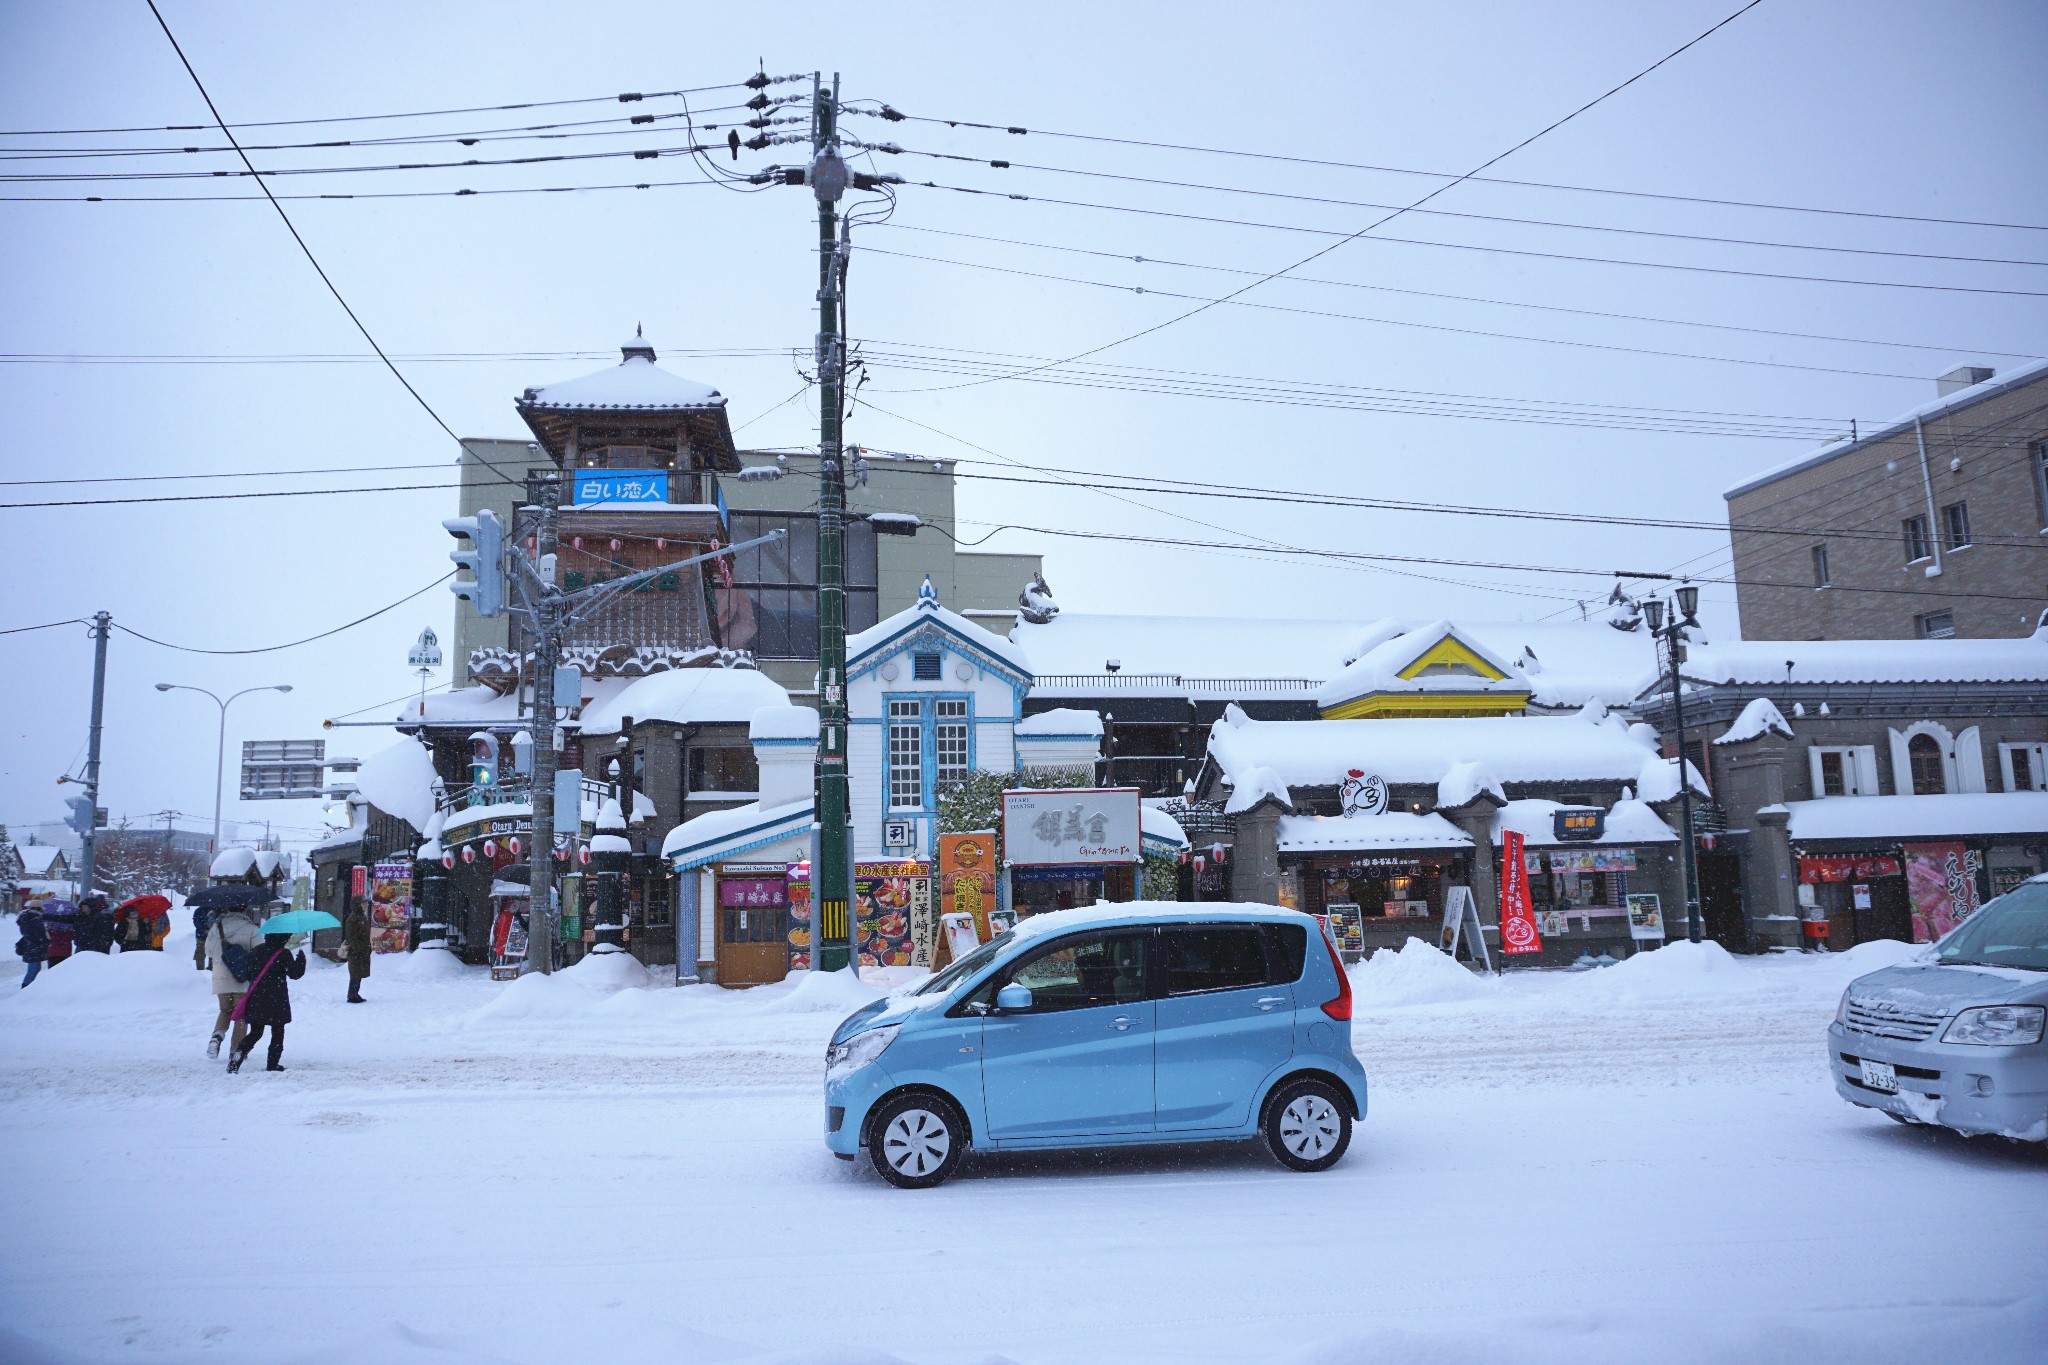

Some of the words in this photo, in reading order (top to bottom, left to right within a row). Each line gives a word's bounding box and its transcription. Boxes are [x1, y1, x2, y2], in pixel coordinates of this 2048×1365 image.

[581, 481, 661, 499] 白い恋人
[491, 821, 512, 832] Otaru
[375, 870, 411, 878] 海鮮食堂
[734, 891, 784, 903] 澤崎水産
[954, 878, 967, 911] たい焼き
[914, 902, 929, 962] 澤崎水産
[1077, 944, 1104, 957] 北海道
[1869, 1071, 1896, 1090] 32-39
